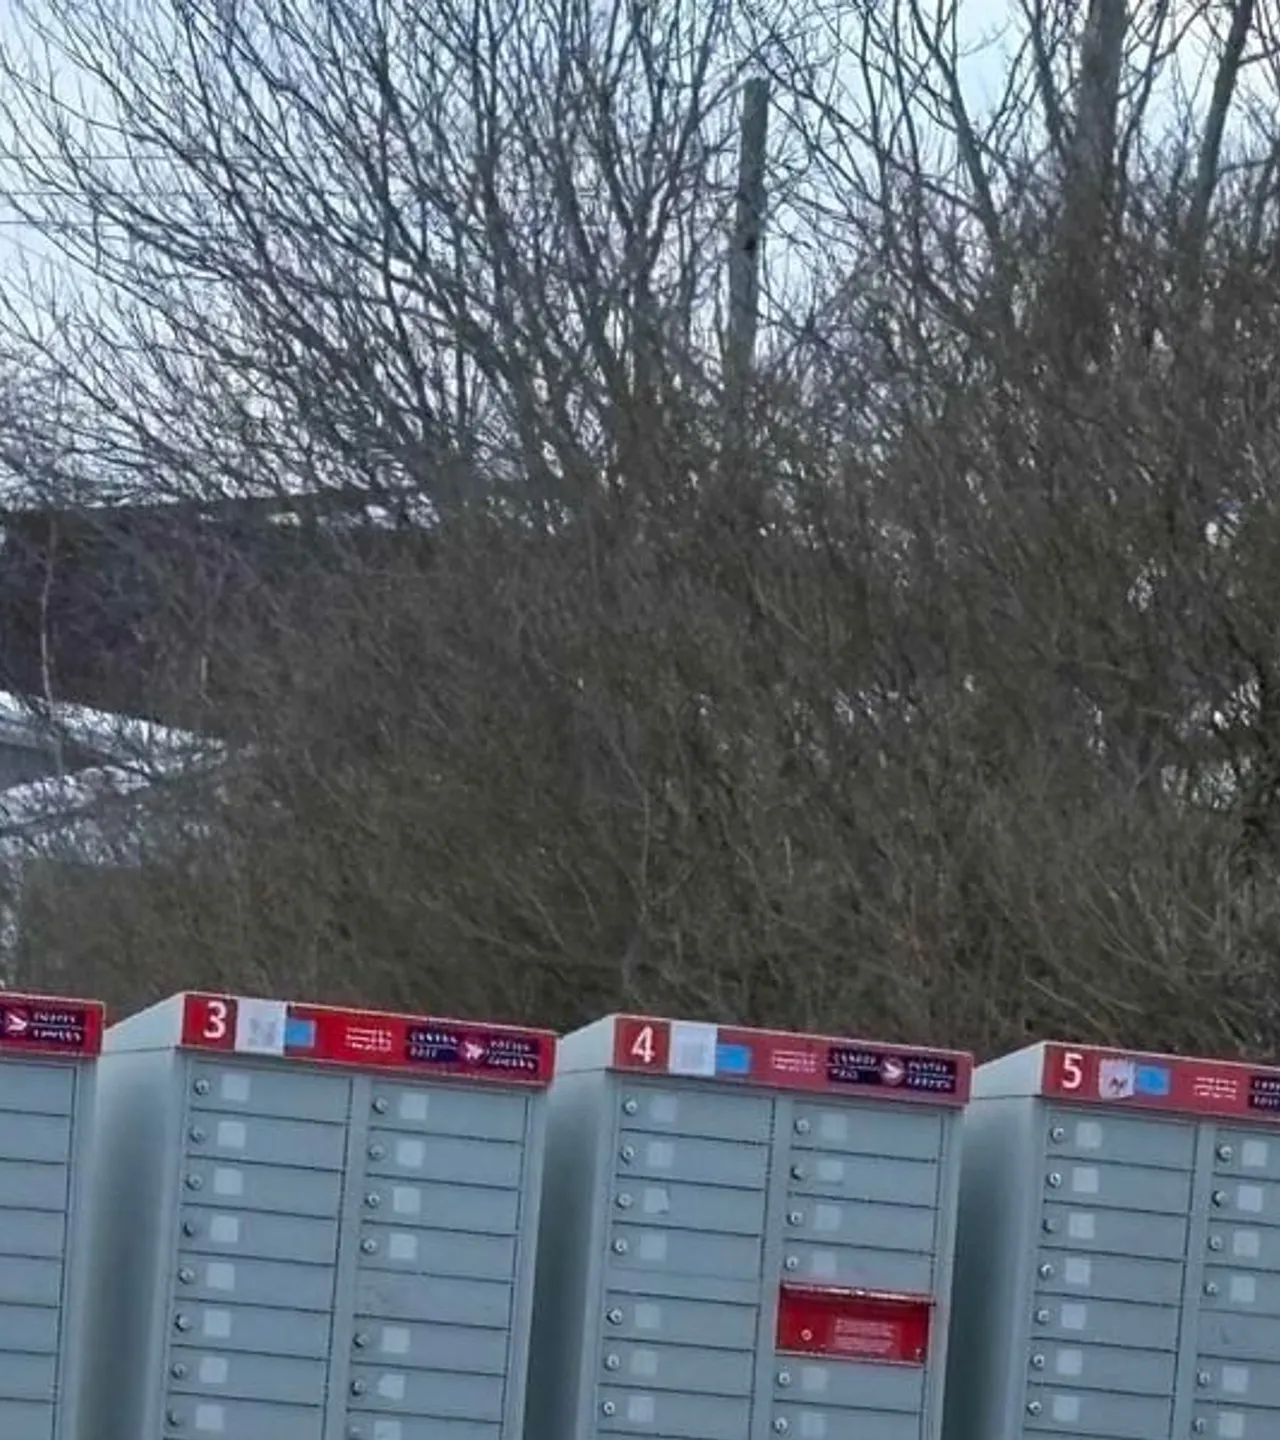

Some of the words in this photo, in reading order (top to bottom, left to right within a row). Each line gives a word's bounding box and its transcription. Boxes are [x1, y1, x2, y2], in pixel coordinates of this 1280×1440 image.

[203, 1001, 228, 1039] 3
[631, 1025, 656, 1063] 4
[1061, 1053, 1083, 1090] 5
